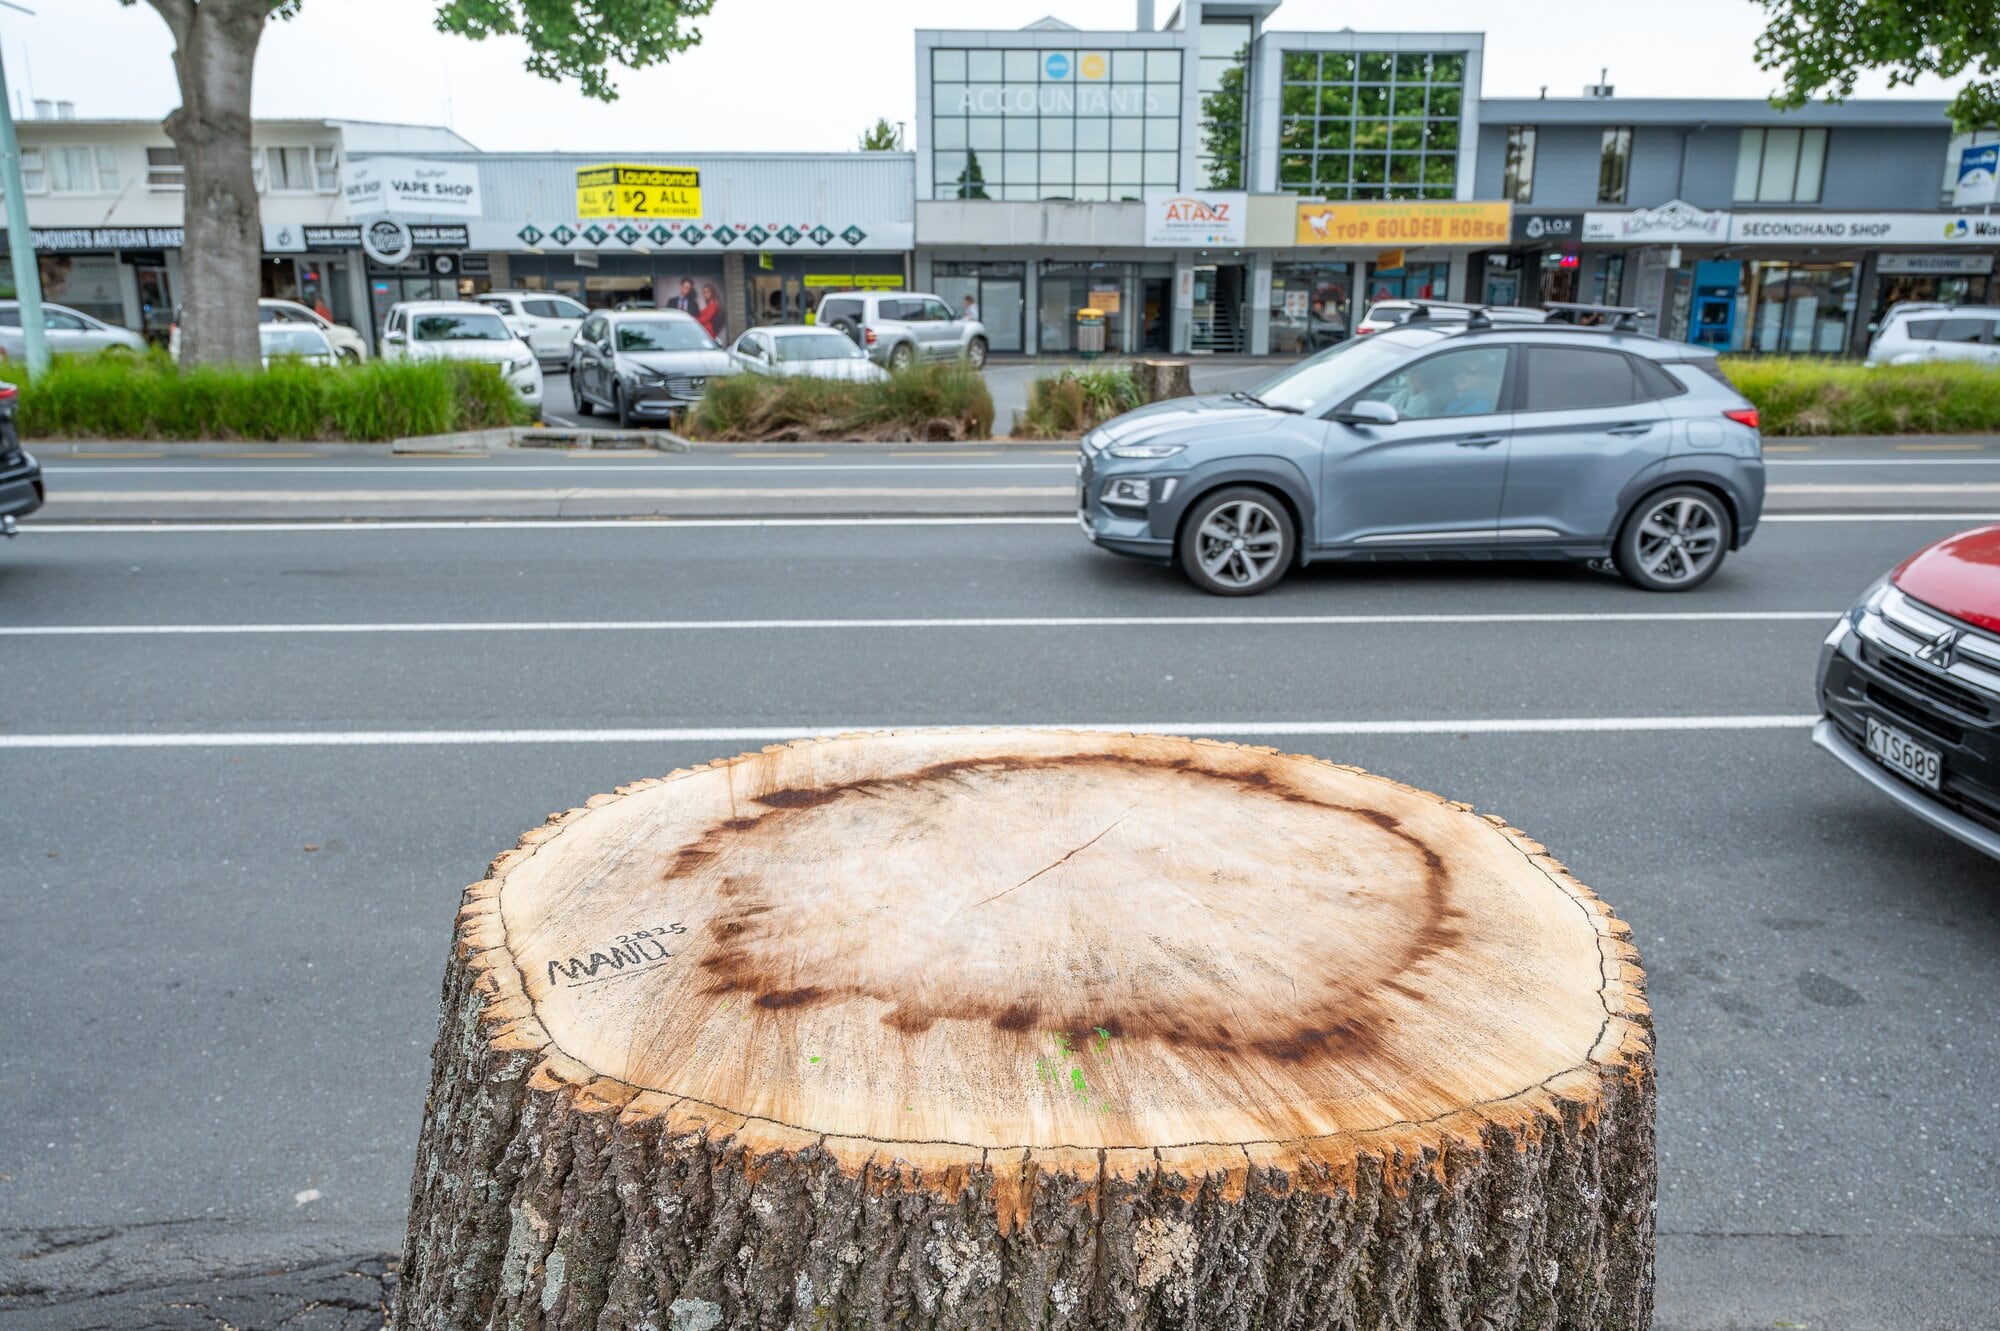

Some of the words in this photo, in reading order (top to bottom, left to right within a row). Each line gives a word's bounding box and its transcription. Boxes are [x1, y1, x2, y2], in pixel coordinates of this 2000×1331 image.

[958, 87, 1159, 112] ACCOUNTANTS
[618, 168, 698, 187] Laundromat
[390, 181, 430, 194] VAPE
[434, 183, 474, 196] SHOP
[660, 190, 690, 204] ALL
[304, 228, 332, 240] VAPE
[331, 228, 361, 240] SHOP
[411, 227, 438, 239] VAPE
[438, 227, 467, 239] SHOP
[1336, 221, 1370, 239] TOP
[1376, 217, 1442, 238] GOLDEN
[1741, 222, 1846, 237] SECONDHAND
[1850, 222, 1892, 237] SHOP
[548, 939, 675, 986] MANU
